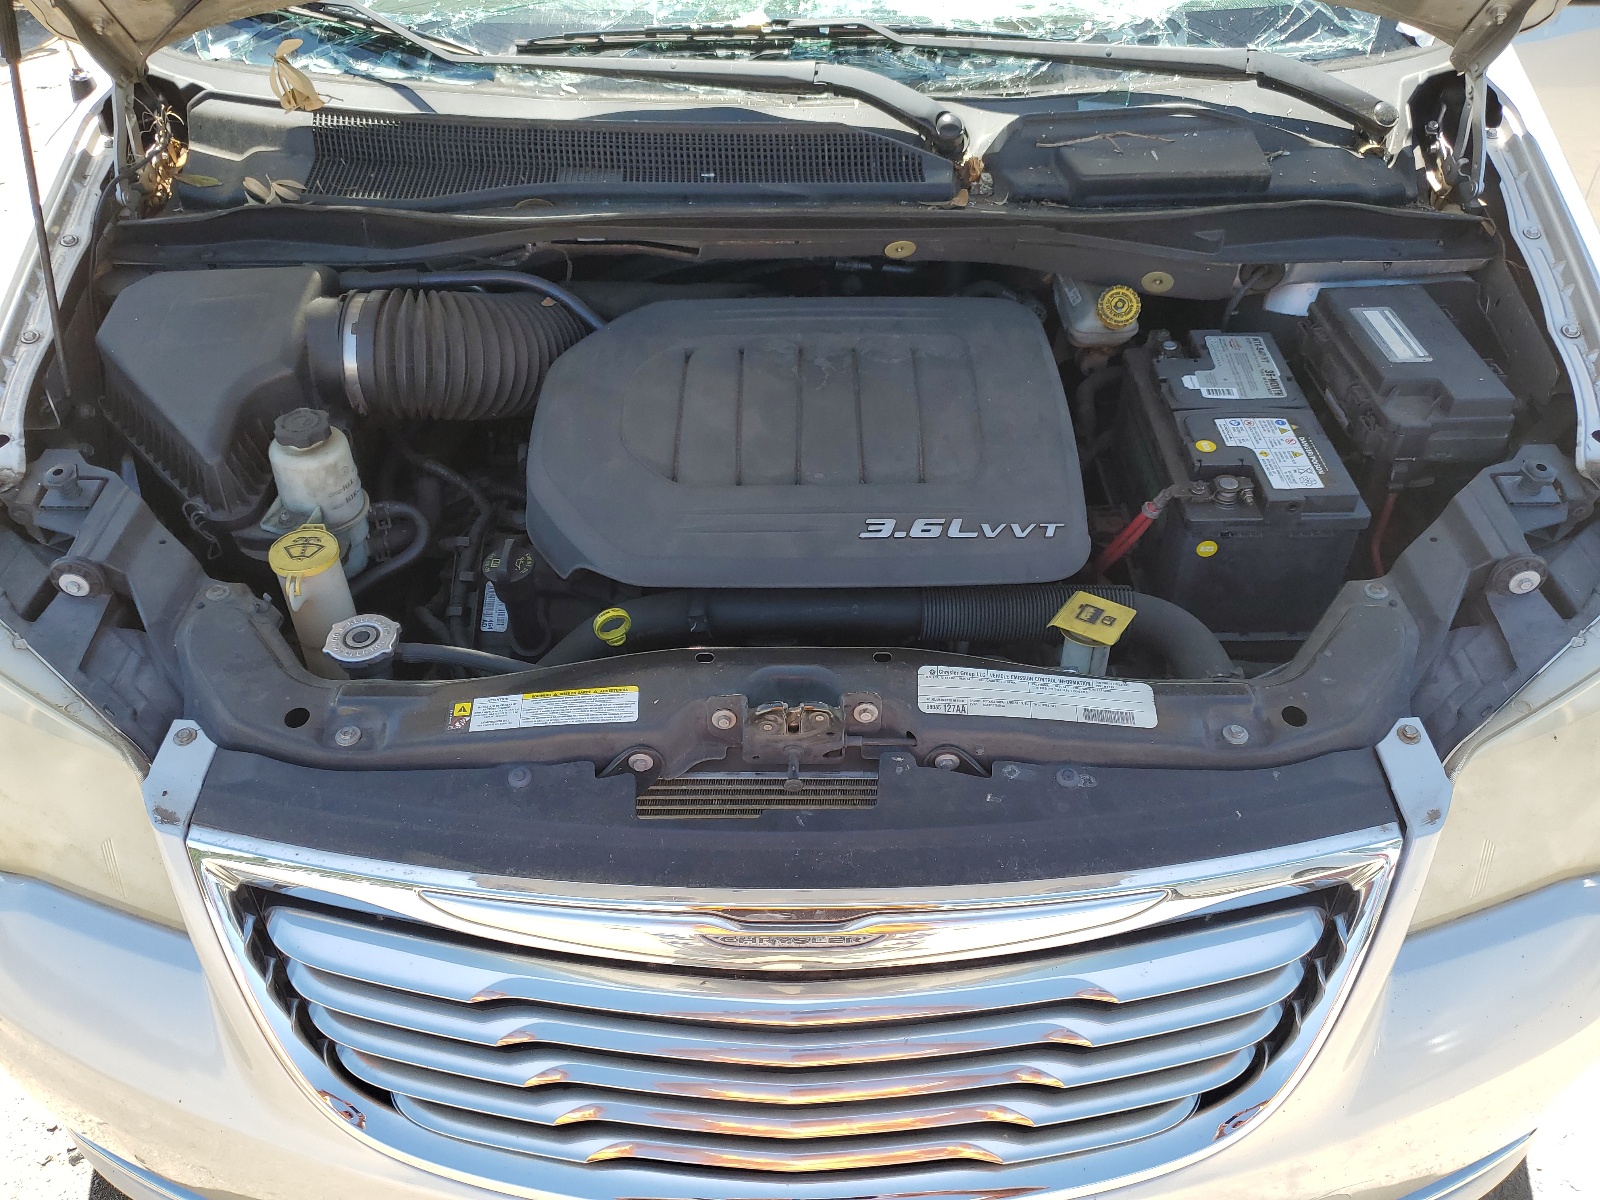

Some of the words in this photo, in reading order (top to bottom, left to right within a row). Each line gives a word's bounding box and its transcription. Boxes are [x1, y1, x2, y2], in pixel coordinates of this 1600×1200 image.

[960, 670, 975, 678] Group
[1010, 674, 1034, 682] EMISSION
[1034, 676, 1057, 684] CONTROL
[944, 704, 966, 714] 127AA
[719, 936, 862, 945] CHRYSLER
